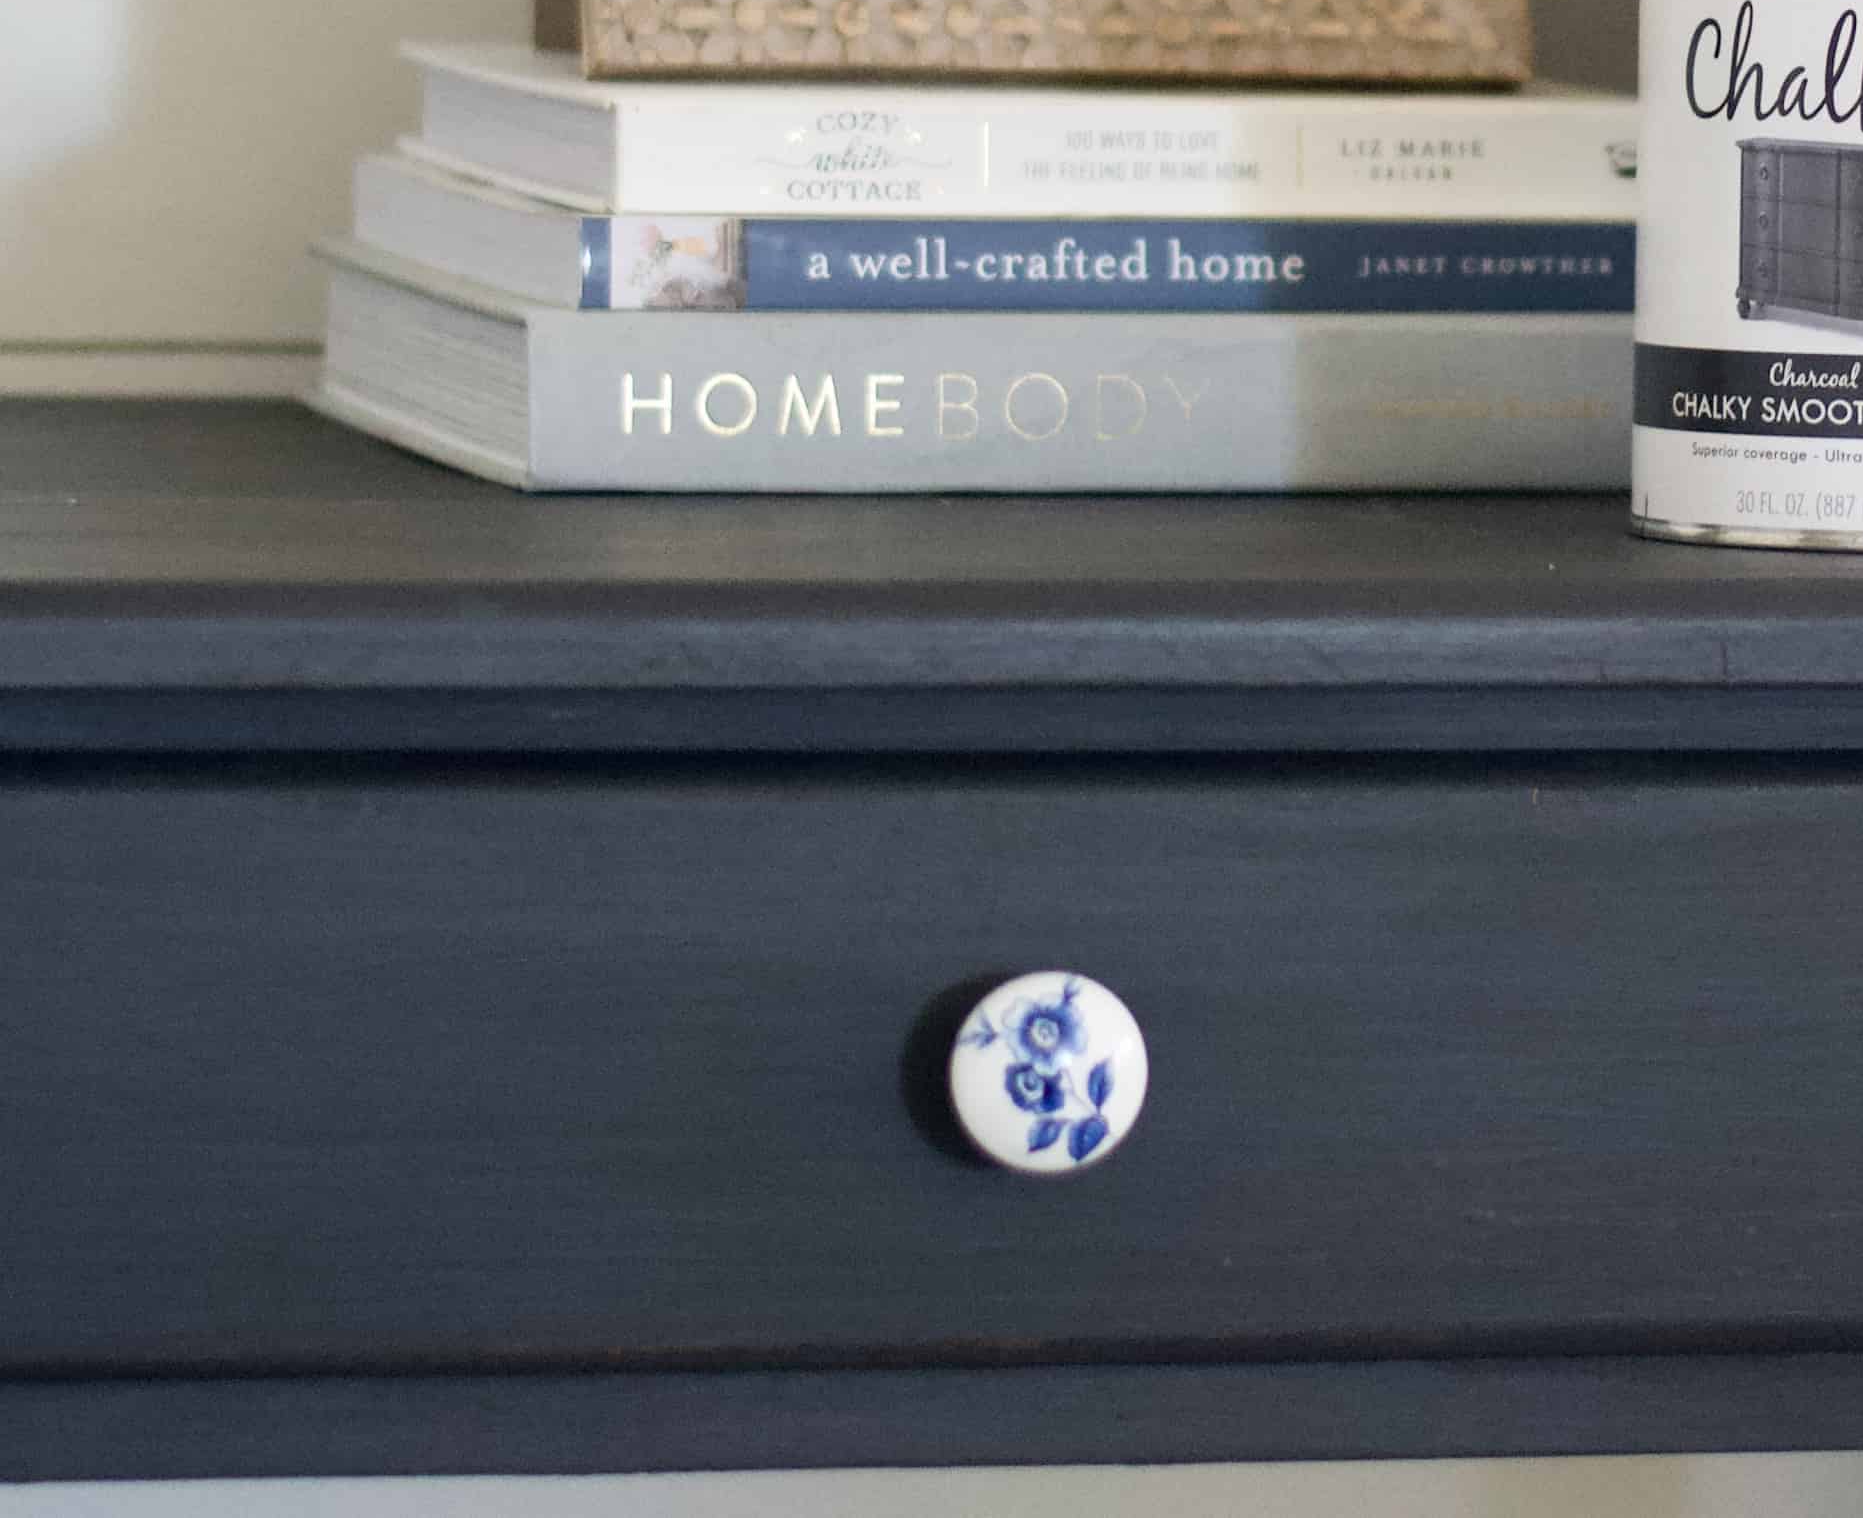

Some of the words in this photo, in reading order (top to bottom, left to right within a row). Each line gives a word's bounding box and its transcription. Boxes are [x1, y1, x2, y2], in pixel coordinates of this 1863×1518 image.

[815, 111, 900, 135] COZY
[1340, 138, 1383, 158] LIZ
[1397, 138, 1486, 158] MARIE
[785, 178, 922, 201] COTTAGE
[807, 251, 832, 281] a
[849, 237, 1150, 282] well-crafted
[1168, 237, 1306, 281] home
[1359, 256, 1448, 278] JANET
[1459, 256, 1614, 276] CROWTHER
[1769, 358, 1861, 389] Charcoal
[1671, 391, 1752, 422] CHALKY
[1692, 442, 1738, 459] Superior
[1743, 448, 1807, 465] coverage
[1825, 449, 1862, 464] Ultra
[1736, 490, 1755, 515] 30
[1816, 492, 1856, 521] (887
